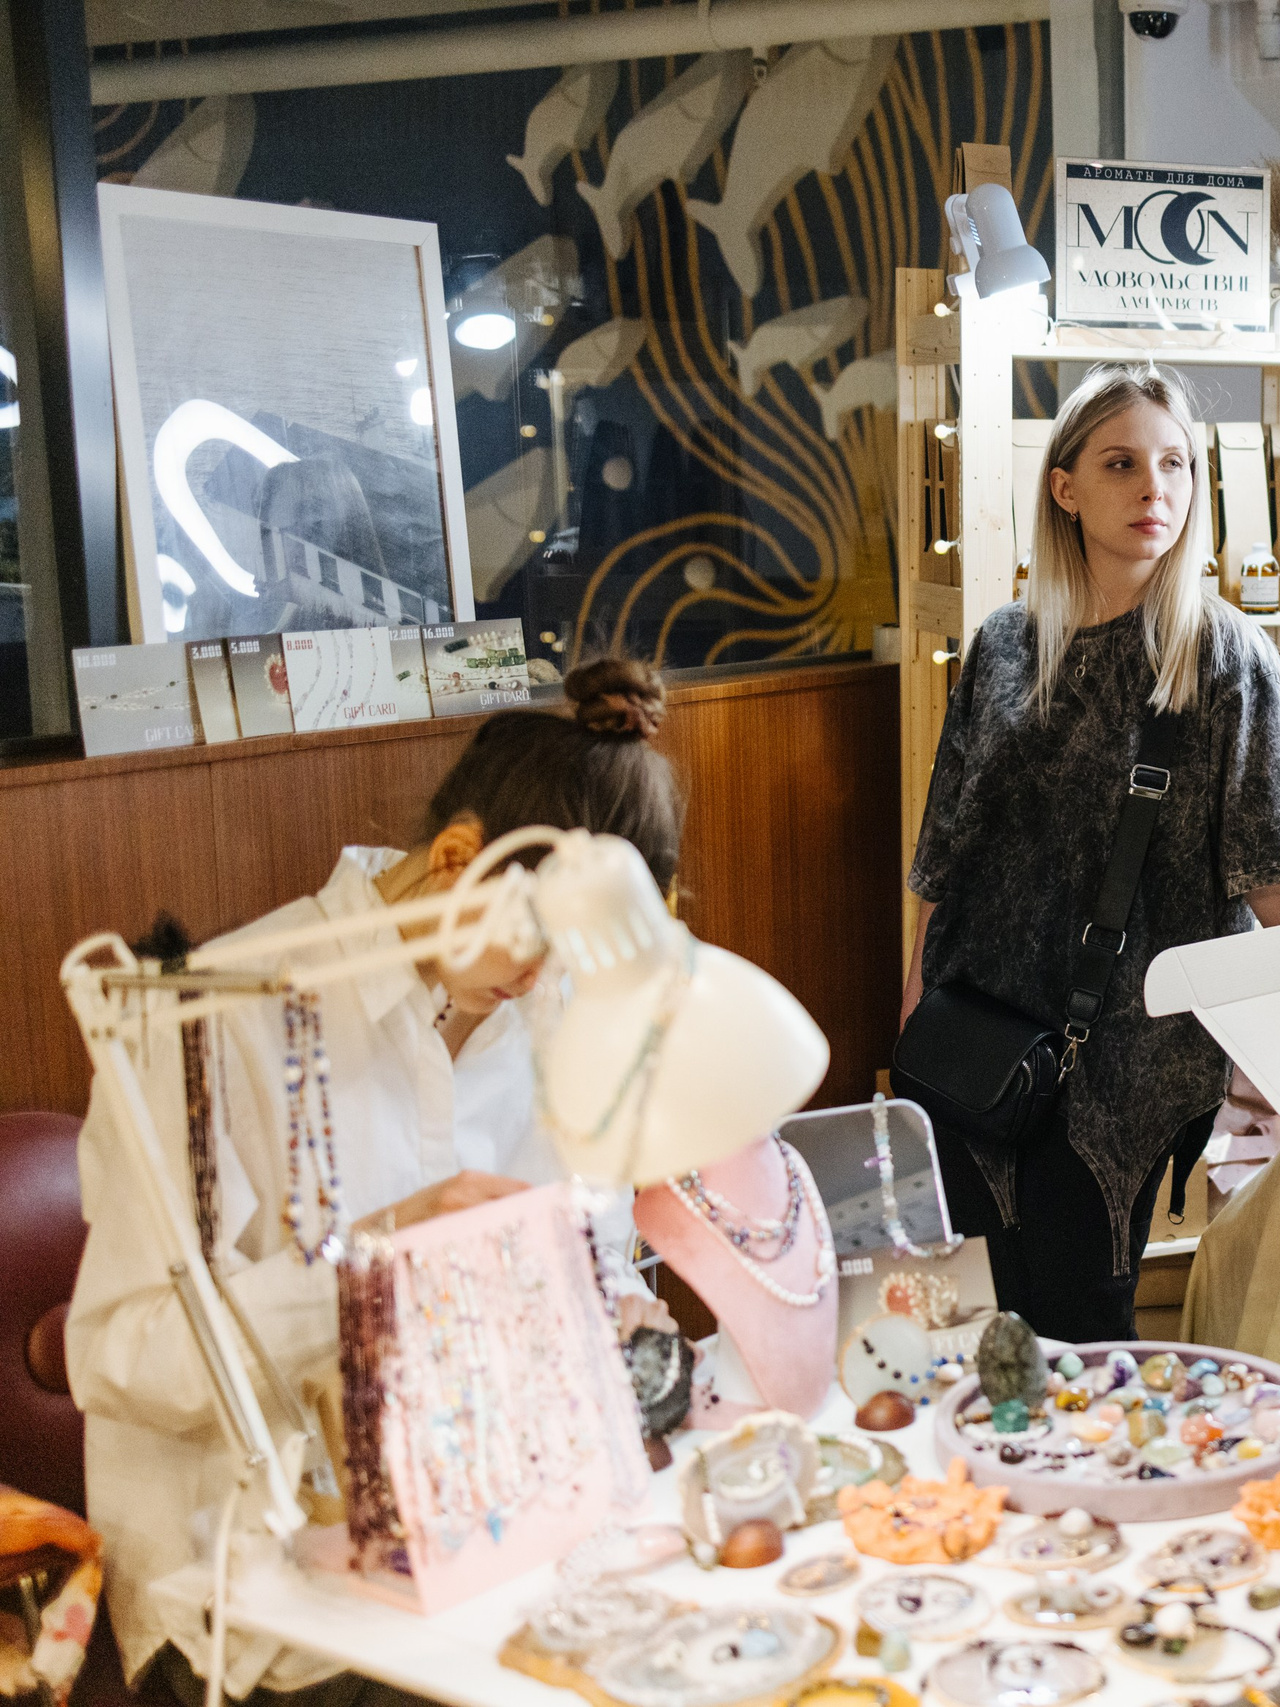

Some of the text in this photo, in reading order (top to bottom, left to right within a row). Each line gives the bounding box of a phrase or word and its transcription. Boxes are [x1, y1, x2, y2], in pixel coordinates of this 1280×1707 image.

[1083, 167, 1246, 188] АРОМАТЫ ДЛЯ ДОМА
[1067, 190, 1258, 265] MOON
[1078, 269, 1252, 292] УДОВОЛЬСТВИЕ
[389, 628, 420, 641] 12.000
[423, 626, 455, 639] 16.000
[191, 644, 222, 660] 3.000
[230, 640, 260, 655] 5.000
[286, 638, 313, 651] 8.000
[479, 688, 530, 706] GIFT CARD
[343, 702, 397, 720] GIFT CARD
